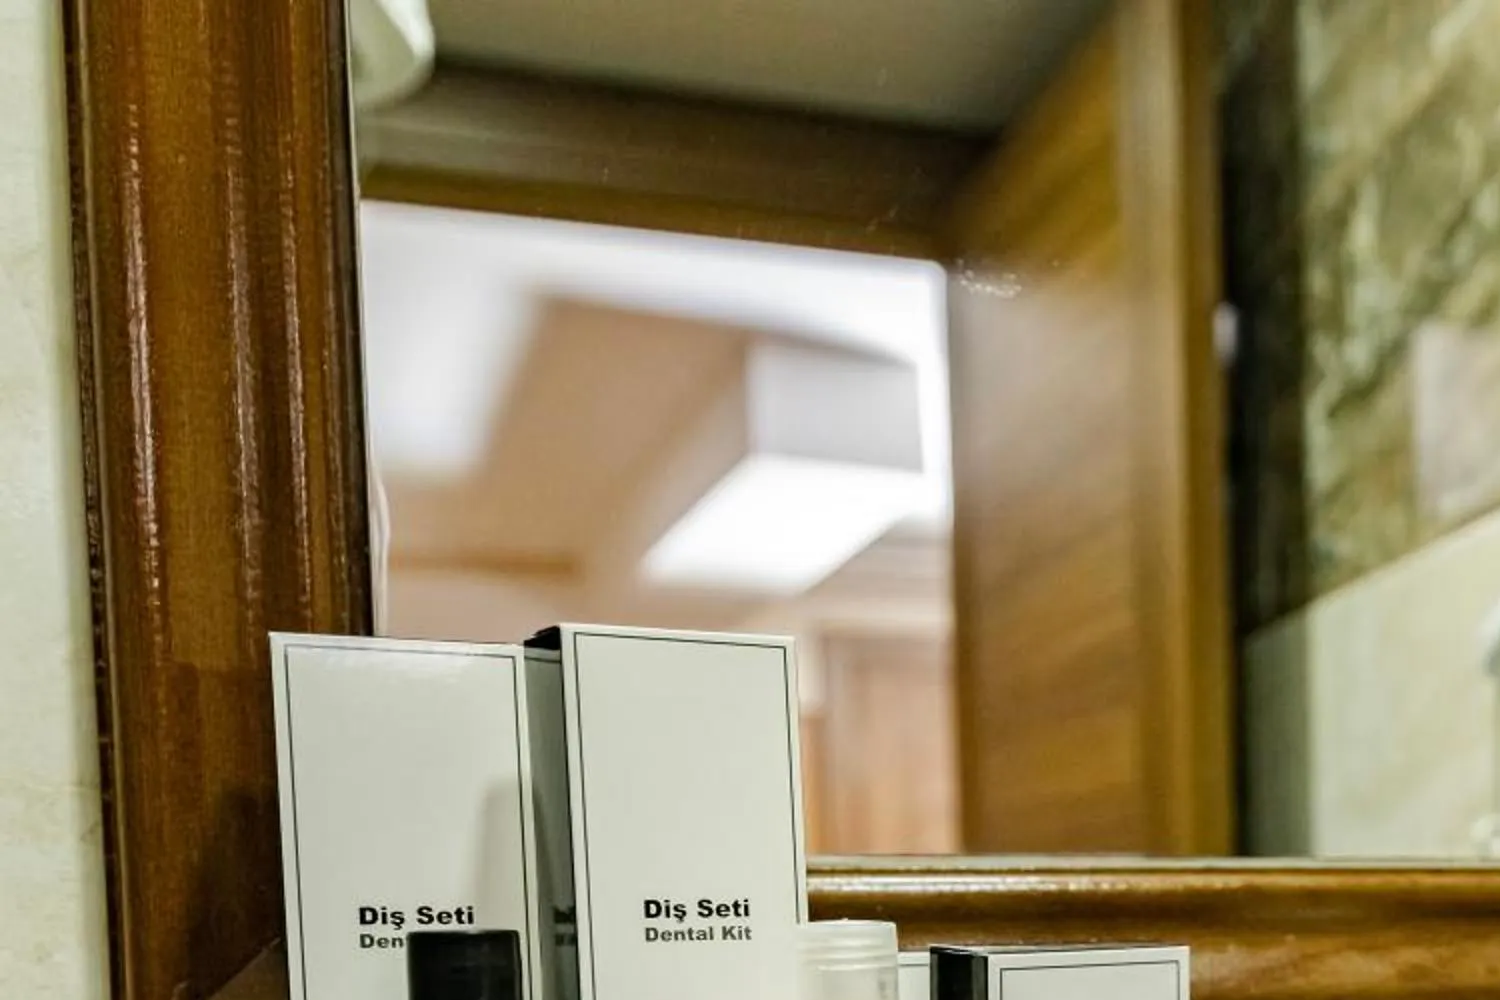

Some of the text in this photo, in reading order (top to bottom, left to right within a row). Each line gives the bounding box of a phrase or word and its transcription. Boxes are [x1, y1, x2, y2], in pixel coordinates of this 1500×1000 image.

[358, 905, 475, 931] Diş Seti
[643, 898, 751, 923] Diş Seti
[359, 933, 404, 949] Den
[645, 925, 752, 942] Dental Kit
